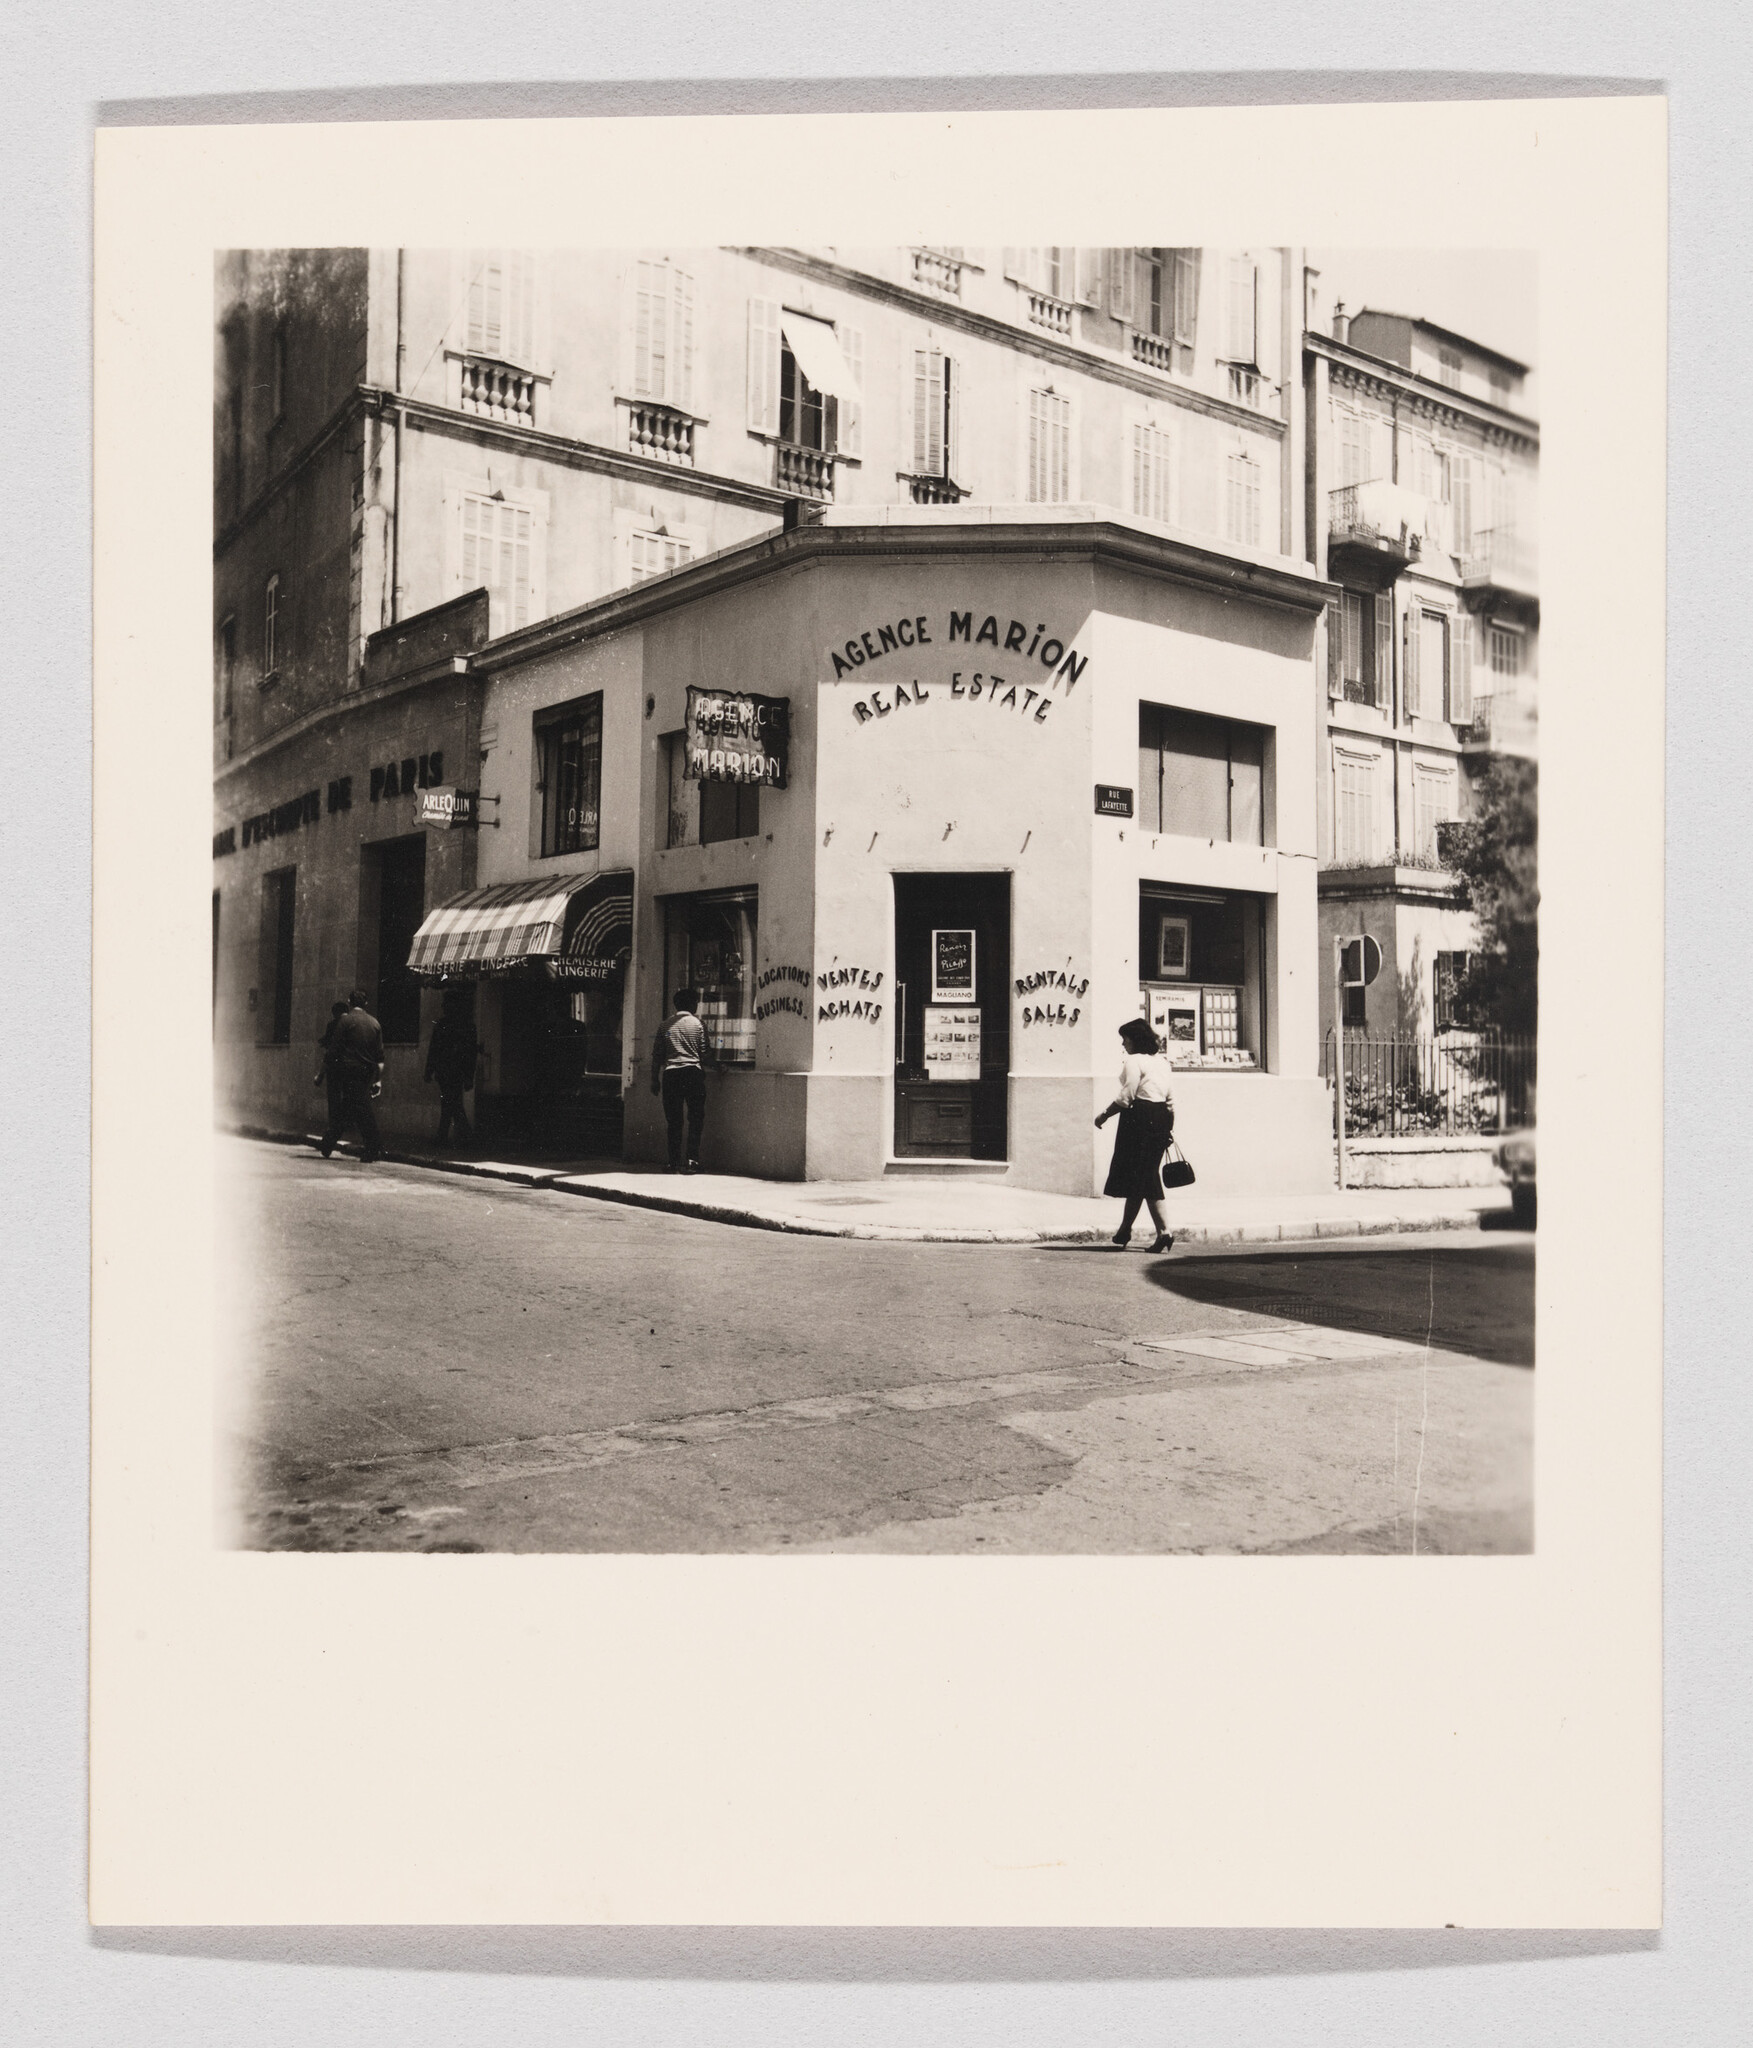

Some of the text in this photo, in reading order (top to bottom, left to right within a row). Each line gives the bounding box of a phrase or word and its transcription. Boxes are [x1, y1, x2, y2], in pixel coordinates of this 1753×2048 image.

[831, 616, 932, 679] AGENCE
[854, 672, 1052, 722] REAL ESTATE
[696, 698, 782, 727] AGENCE
[693, 748, 780, 778] MARION
[327, 776, 352, 815] DE
[369, 751, 443, 803] PARIS
[422, 794, 470, 813] ARLEQUIN
[1108, 790, 1120, 799] RUE
[1101, 801, 1128, 811] LAFAYETTE
[551, 957, 616, 969] CHEMISERIE
[558, 966, 608, 979] LINGERIE
[758, 966, 810, 989] LOCATIONS
[818, 967, 884, 989] VENTES
[1016, 970, 1089, 994] RENTALS
[819, 1000, 882, 1020] ACHATS
[1023, 1004, 1081, 1023] SALES
